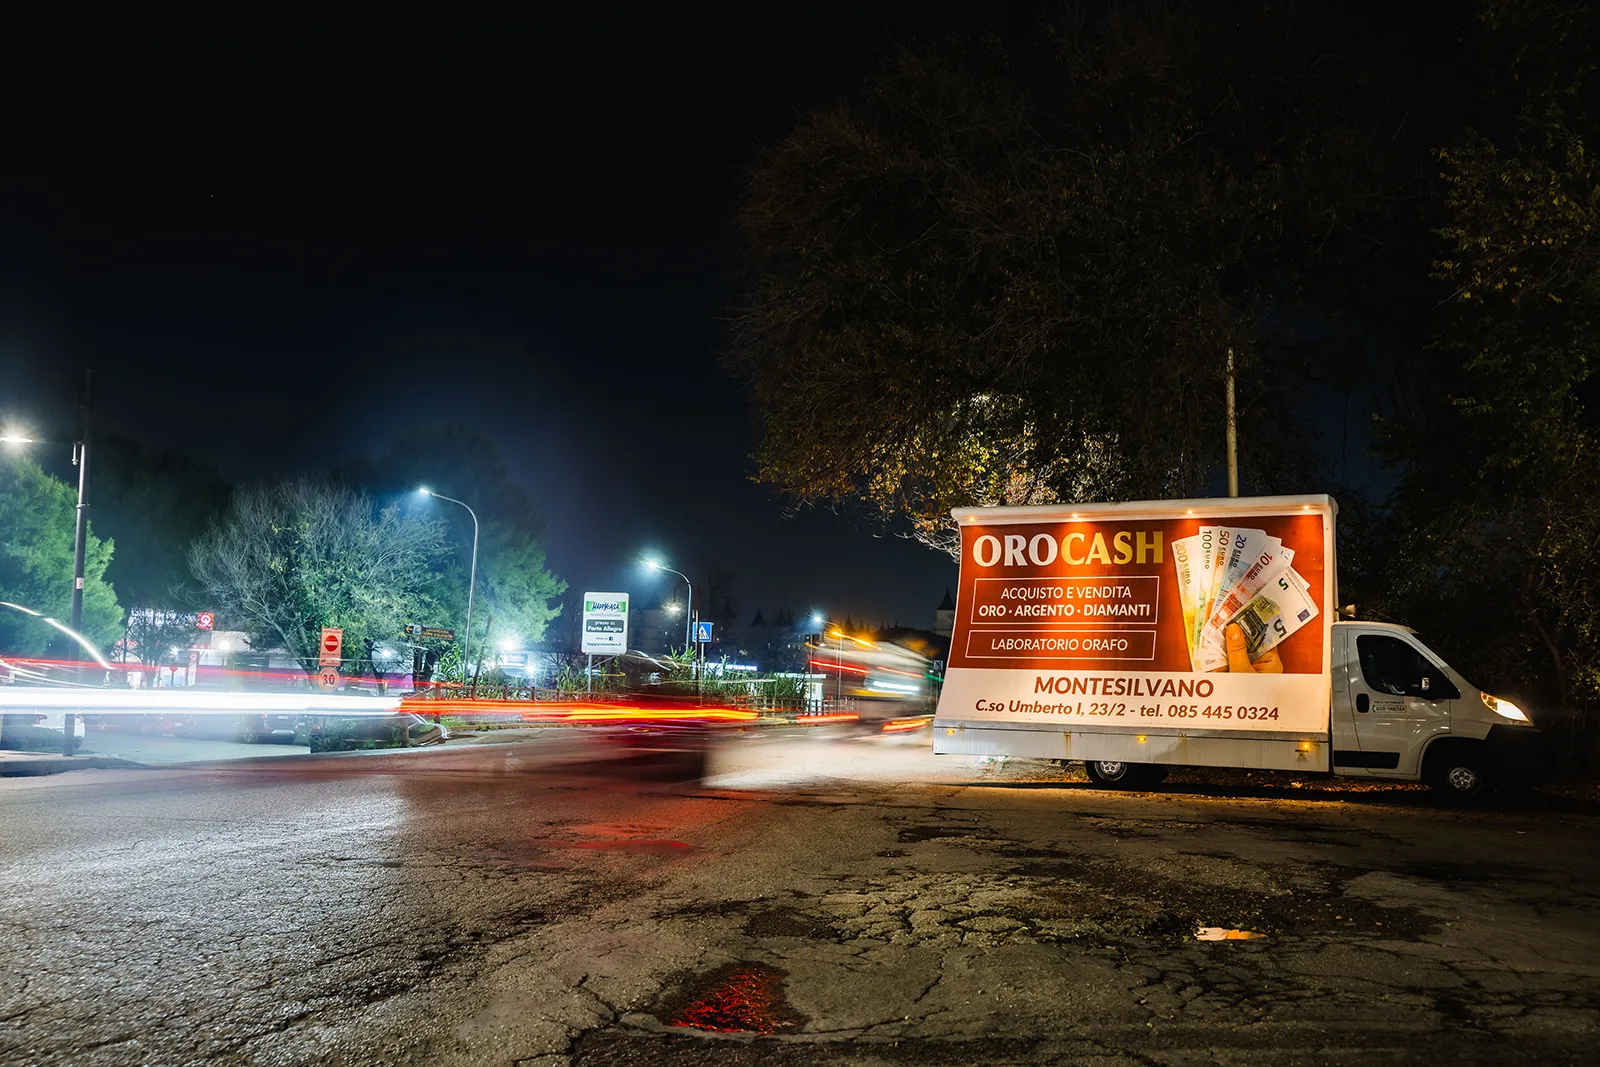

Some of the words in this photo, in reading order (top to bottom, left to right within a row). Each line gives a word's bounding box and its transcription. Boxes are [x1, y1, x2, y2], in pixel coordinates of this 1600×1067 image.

[1201, 529, 1213, 550] 100
[1218, 529, 1231, 546] 50
[1234, 533, 1247, 549] 20
[1174, 541, 1189, 563] 200
[1182, 562, 1192, 585] EURO
[1204, 549, 1212, 570] EURO
[1219, 547, 1227, 566] EURO
[1232, 549, 1243, 568] EURO
[1260, 551, 1273, 566] 10
[1250, 565, 1265, 581] EURO
[1278, 577, 1290, 591] 5
[1000, 587, 1064, 602] ACQUISTO
[1066, 586, 1074, 599] E
[1076, 586, 1132, 599] VENDITA
[978, 604, 1007, 617] ORO
[1014, 604, 1075, 617] ARGENTO
[1083, 603, 1150, 617] DIAMANTI
[1273, 618, 1288, 639] 5
[991, 638, 1079, 651] LABORATORIO
[1081, 638, 1129, 651] ORAFO
[322, 674, 336, 686] 30
[1034, 676, 1214, 699] MONTESILVANO
[975, 698, 1005, 712] C.so
[1008, 699, 1073, 715] Umberto
[1088, 701, 1126, 717] 23/2
[1139, 703, 1164, 718] tel.
[1167, 704, 1198, 719] 085
[1201, 705, 1233, 719] 445
[1236, 706, 1280, 721] 0324
